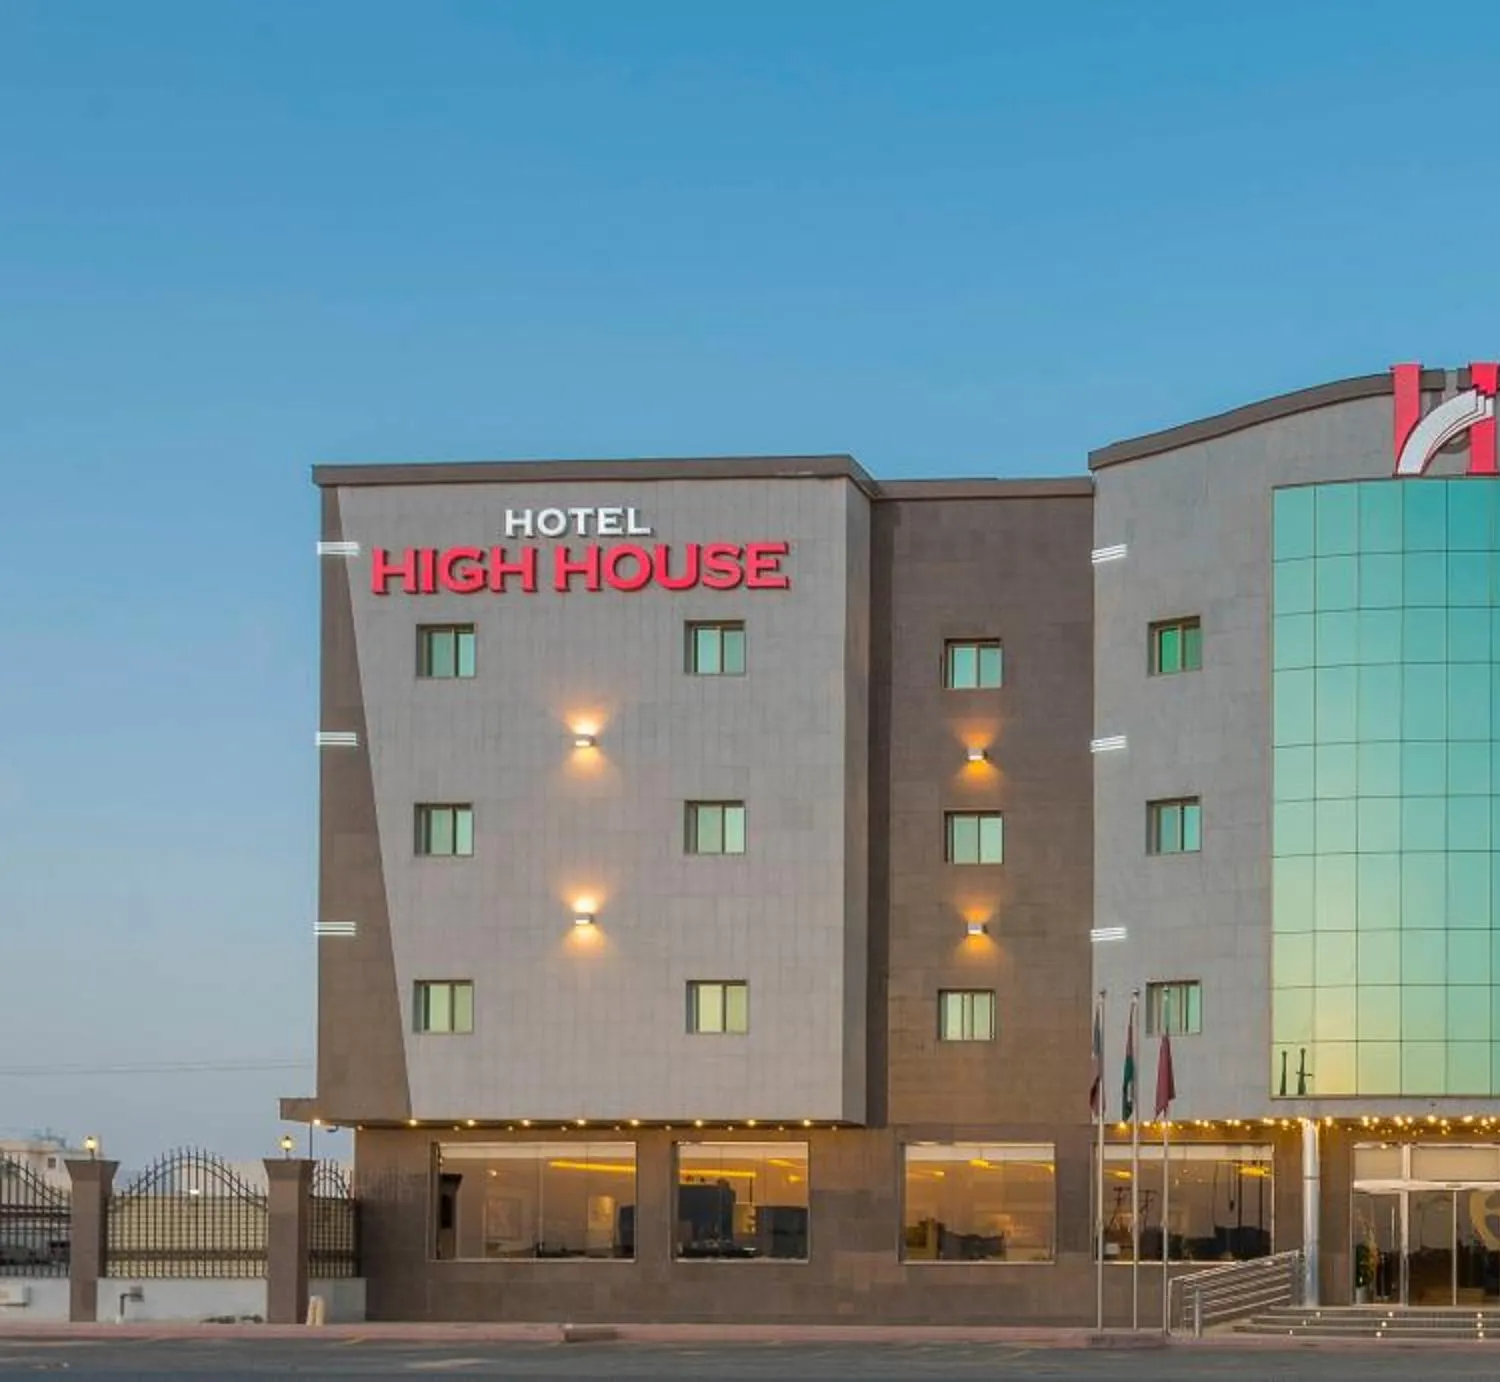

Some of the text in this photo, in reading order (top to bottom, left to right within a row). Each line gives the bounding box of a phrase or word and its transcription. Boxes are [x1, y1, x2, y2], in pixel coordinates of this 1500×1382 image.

[504, 507, 653, 538] HOTEL
[371, 542, 790, 595] HIGH HOUSE
